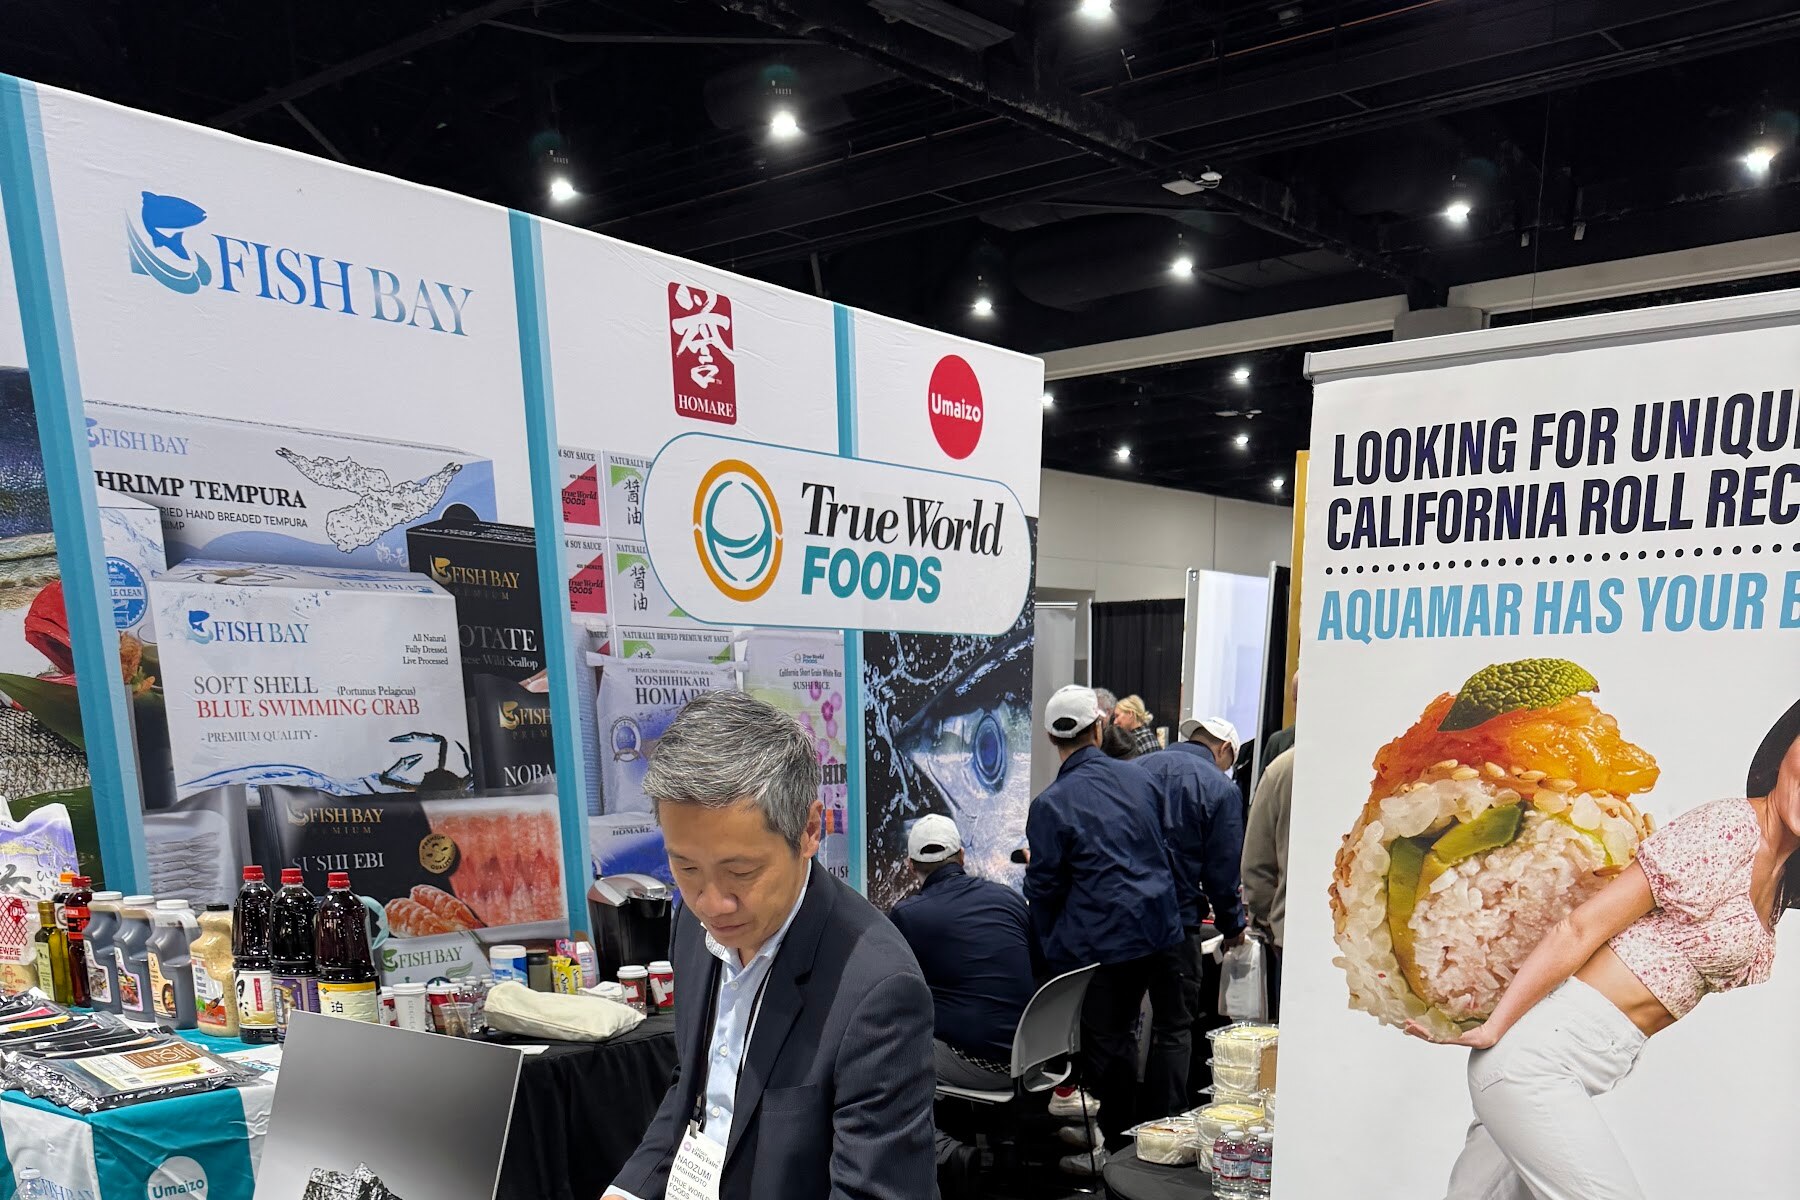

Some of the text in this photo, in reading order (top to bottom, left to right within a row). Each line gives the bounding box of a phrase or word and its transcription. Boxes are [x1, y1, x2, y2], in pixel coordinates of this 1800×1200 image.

[211, 233, 474, 337] FISH BAY
[678, 395, 734, 418] HOMARE
[930, 392, 982, 422] Umaizo
[100, 428, 189, 455] FISH BAY
[1333, 389, 1800, 487] LOOKING FOR UNIQU
[94, 470, 307, 509] HRIMP TEMPURA
[577, 489, 597, 500] World
[562, 497, 586, 506] FOODS
[1327, 463, 1800, 551] CALIFORNIA ROLL REC
[161, 506, 307, 528] RIED HAND BREADED TEMPURA
[162, 519, 185, 531] RIMP
[802, 482, 1003, 557] True World
[451, 567, 519, 588] FISH BAY
[583, 579, 604, 589] World
[801, 546, 943, 604] FOODS
[569, 587, 593, 595] FOODS
[1318, 570, 1768, 645] AQUAMAR HAS YOUR
[214, 621, 310, 644] FISH BAY
[412, 634, 447, 644] All Natural
[459, 624, 538, 653] OTATE
[403, 656, 448, 666] Live Processed
[405, 645, 448, 656] Fully Dressed
[507, 657, 539, 671] Scallop
[193, 676, 319, 695] SOFT SHELL
[635, 675, 710, 687] KOSHIHIKARI
[337, 686, 416, 698] (Portunus Pelagicus)
[197, 698, 420, 719] BLUE SWIMMING CRAB
[518, 708, 552, 725] FISH
[207, 730, 313, 743] PREMIUM QUALITY
[504, 764, 556, 786] NOBA
[309, 807, 384, 824] FISH BAY
[354, 852, 384, 869] EBI
[0, 947, 22, 957] EWPIE
[399, 946, 463, 970] FISH BAY
[677, 1154, 712, 1182] NAOZUMI
[152, 1179, 205, 1200] Umaizo
[671, 1175, 688, 1191] TRUE
